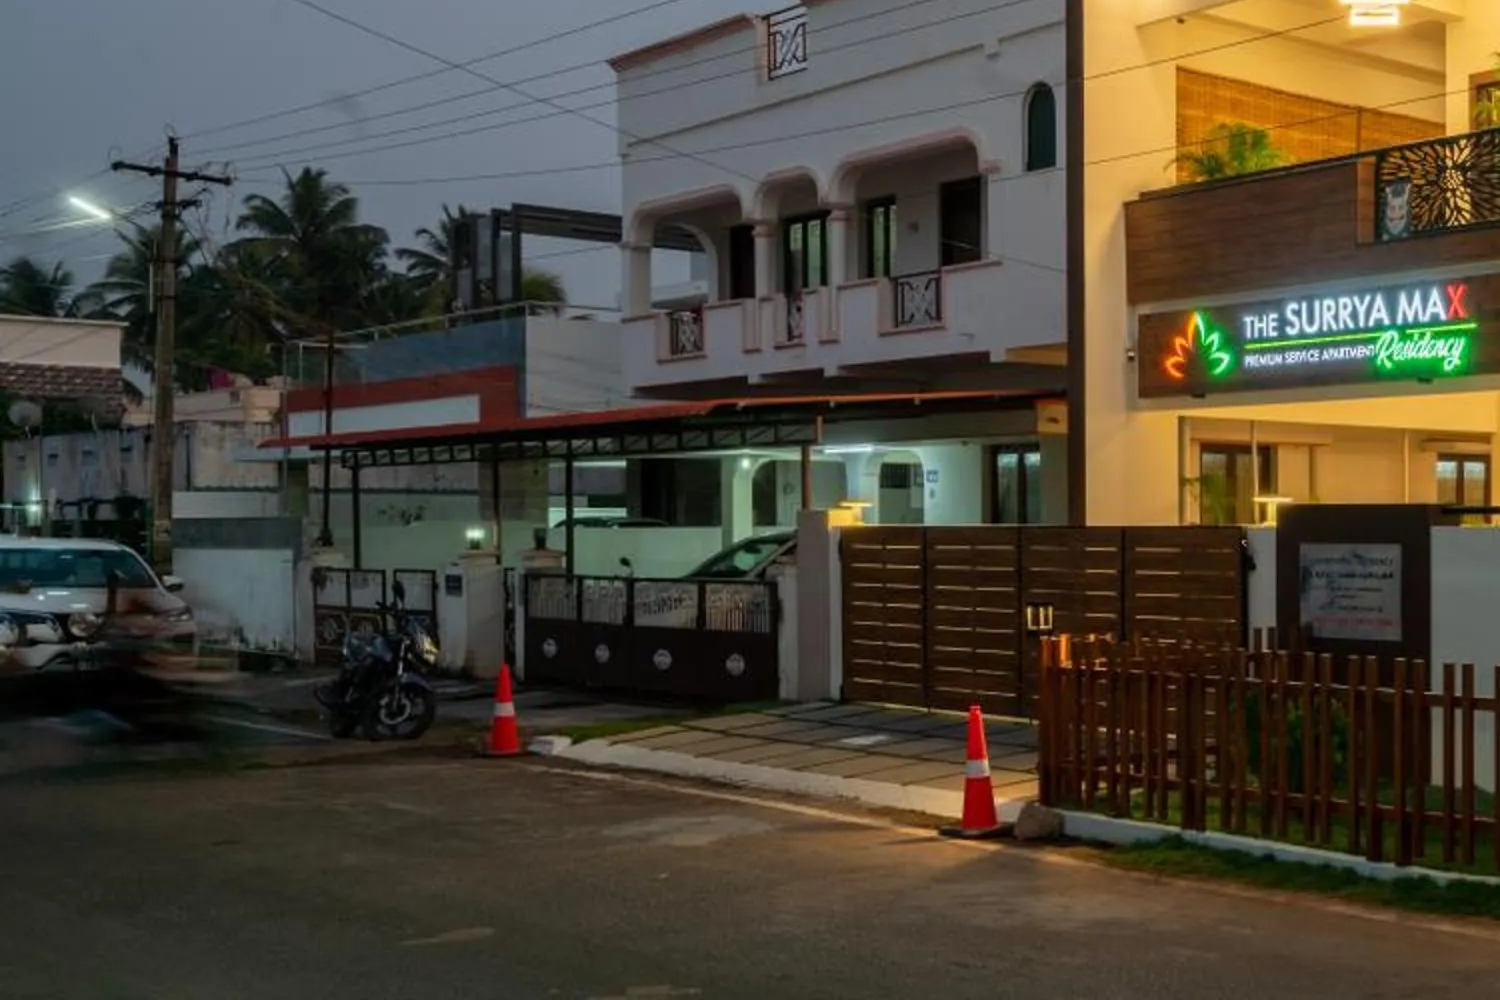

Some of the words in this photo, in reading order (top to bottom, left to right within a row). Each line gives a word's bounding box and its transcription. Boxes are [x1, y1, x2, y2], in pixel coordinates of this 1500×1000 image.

[1243, 313, 1278, 339] THE
[1285, 295, 1389, 335] SURRYA
[1396, 283, 1468, 325] MAX
[1244, 354, 1282, 368] PREMIUM
[1375, 329, 1466, 371] Residency
